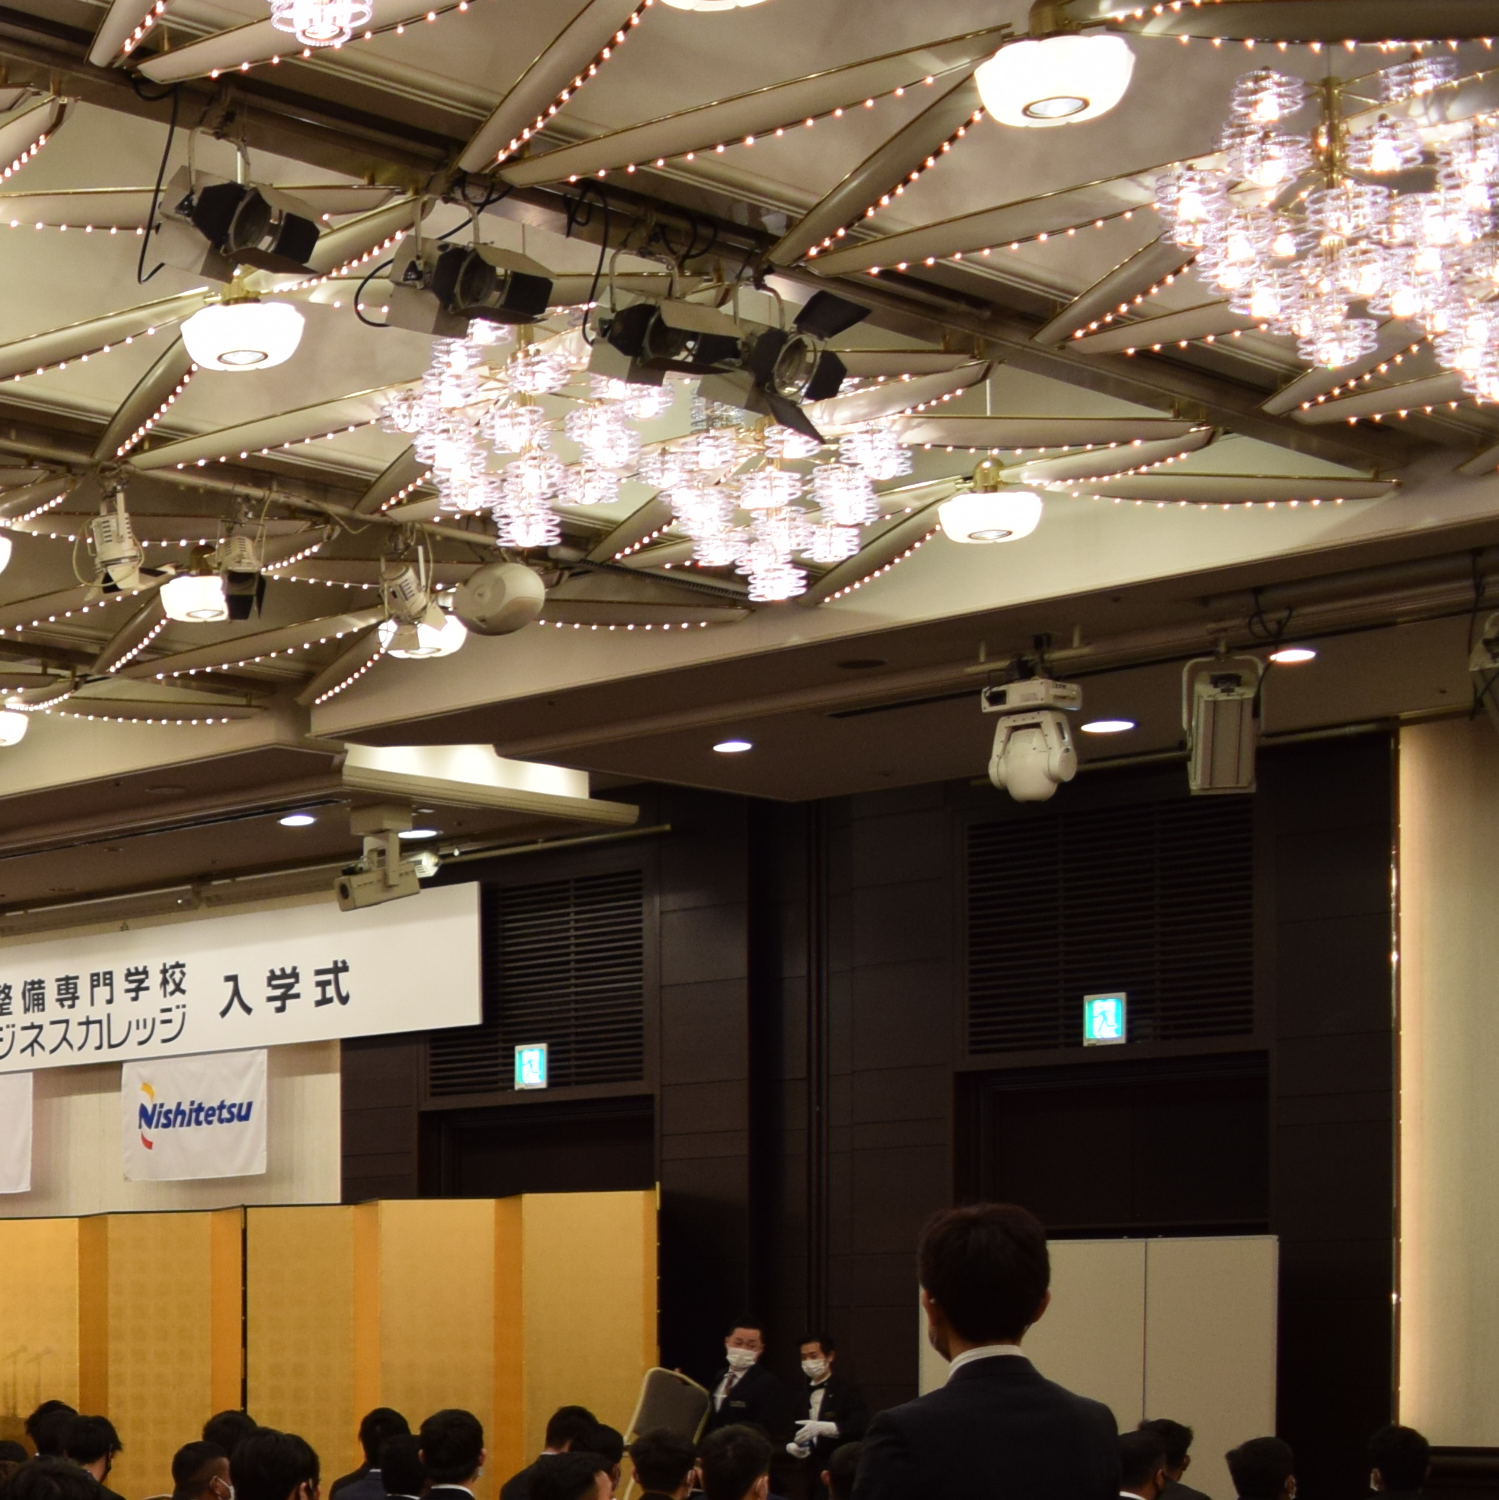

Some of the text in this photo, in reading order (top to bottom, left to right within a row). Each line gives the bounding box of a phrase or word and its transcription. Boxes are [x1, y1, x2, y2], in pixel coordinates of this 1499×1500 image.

[219, 959, 351, 1019] 入学式
[138, 1099, 254, 1130] Nishitetsu
